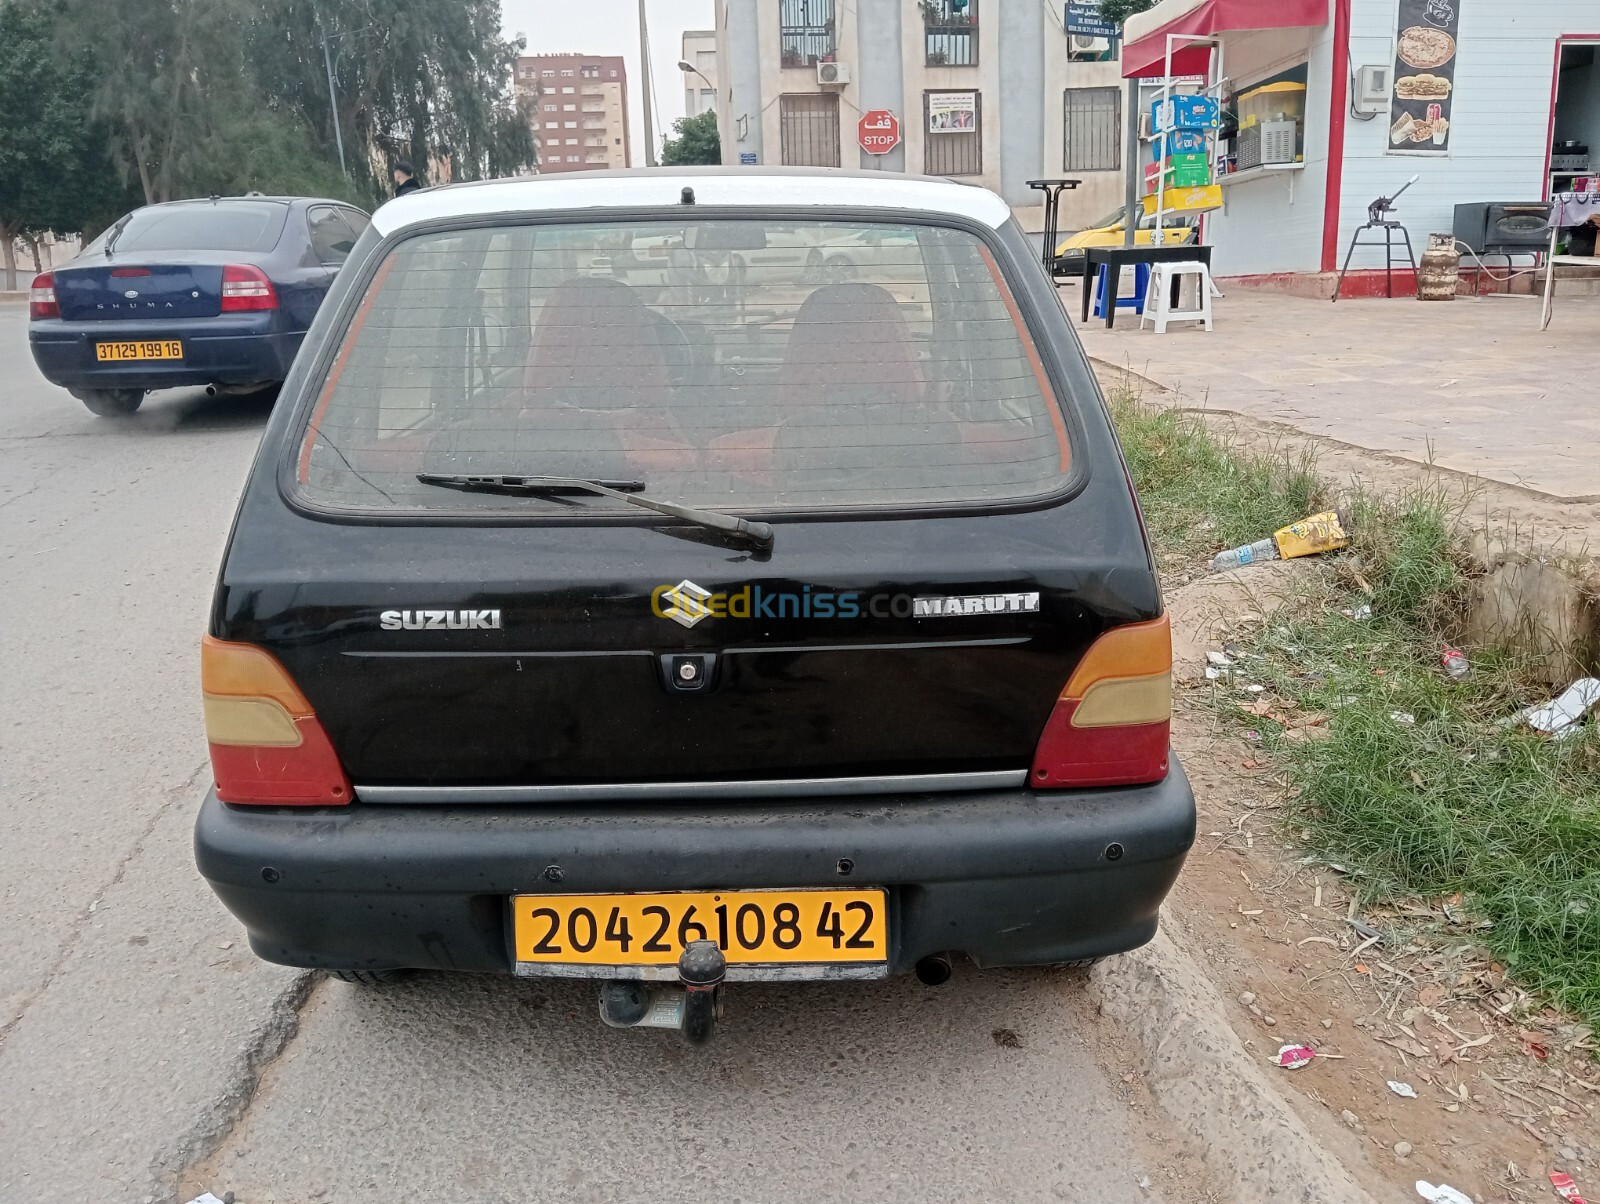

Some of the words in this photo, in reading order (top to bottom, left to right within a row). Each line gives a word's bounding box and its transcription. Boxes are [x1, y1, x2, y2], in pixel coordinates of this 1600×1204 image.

[864, 115, 891, 129] قف
[864, 136, 894, 145] STOP
[99, 344, 137, 359] 37129
[140, 343, 162, 358] 199
[165, 342, 180, 356] 16
[915, 594, 1039, 615] MARUTI
[380, 609, 501, 630] SUZUKI
[816, 901, 874, 949] 42
